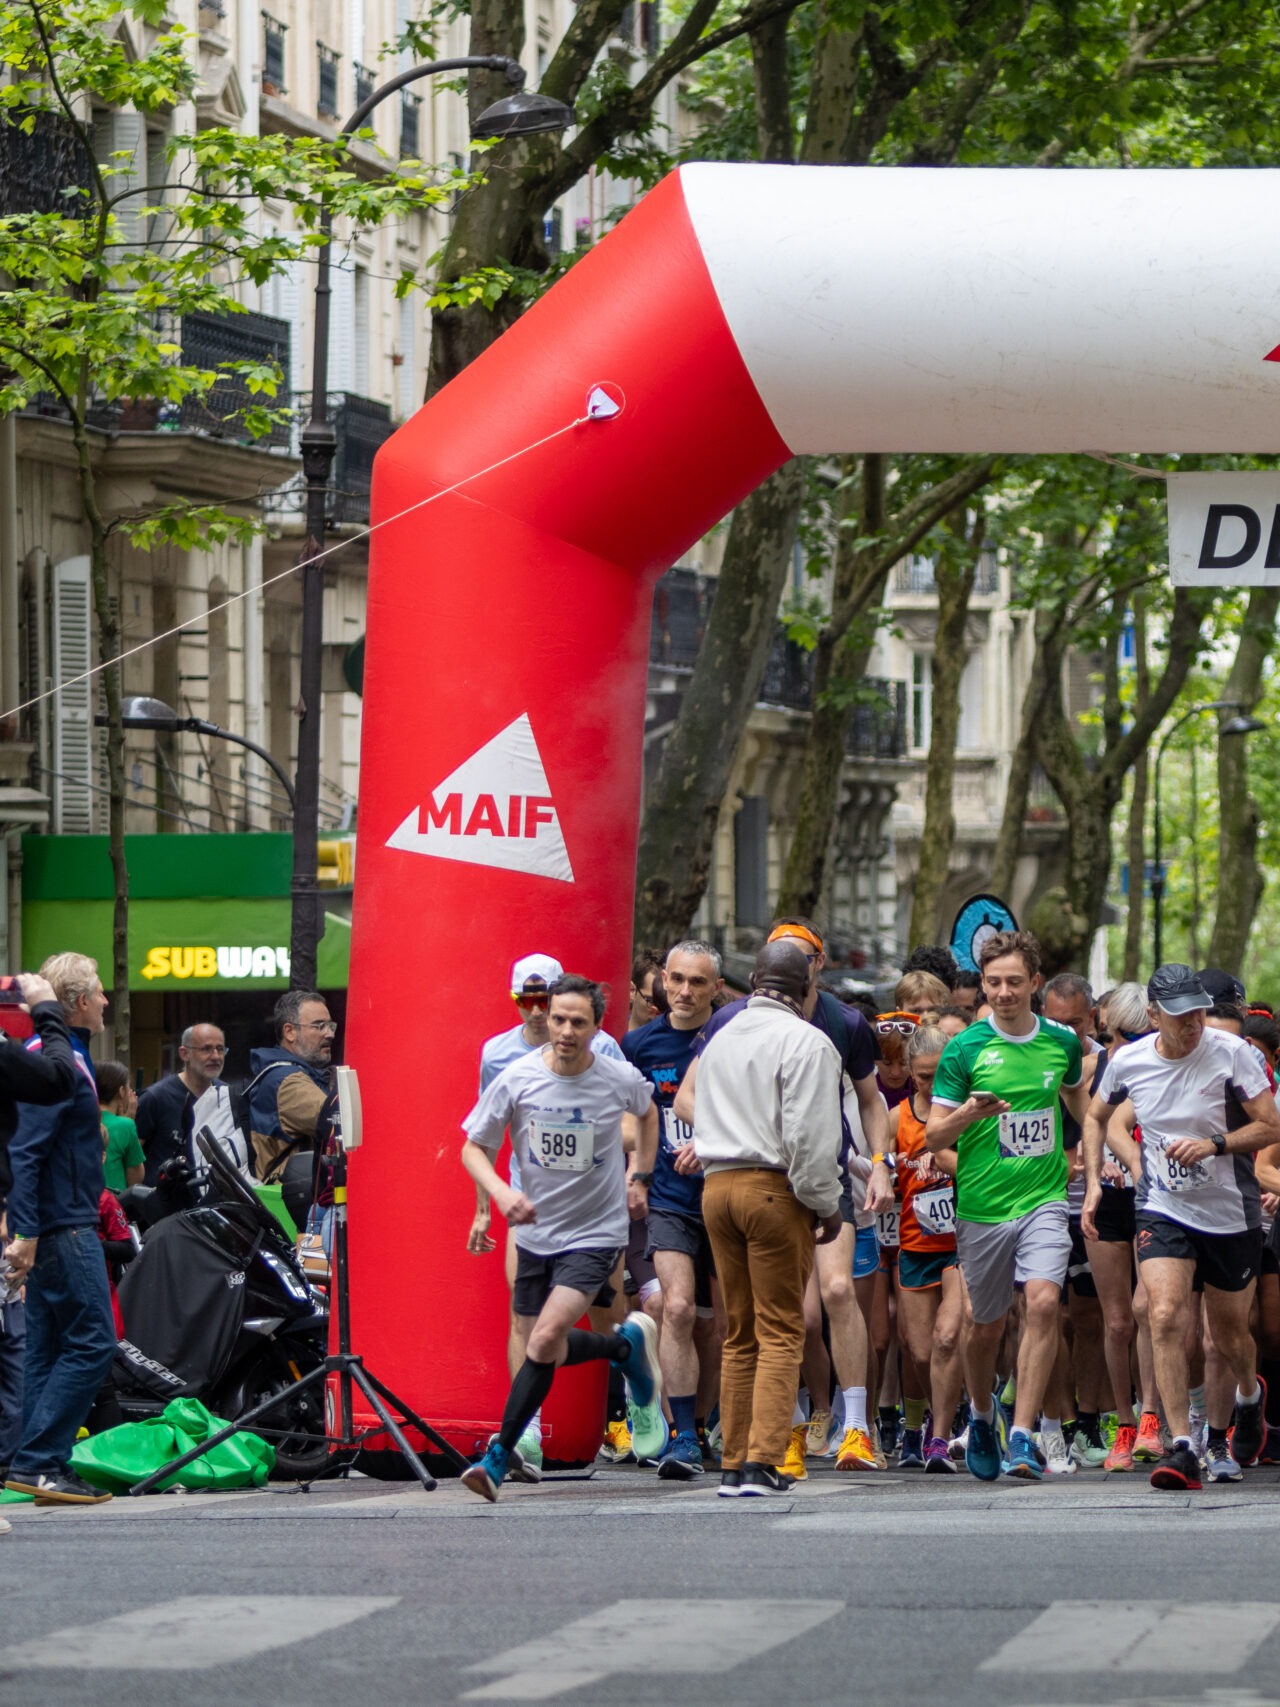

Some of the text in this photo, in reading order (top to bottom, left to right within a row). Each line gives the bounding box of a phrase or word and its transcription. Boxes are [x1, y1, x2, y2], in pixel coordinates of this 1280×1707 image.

[417, 792, 556, 838] MAIF
[140, 946, 291, 980] SUBWAY
[1009, 1118, 1049, 1144] 1425
[541, 1132, 577, 1157] 589
[878, 1212, 900, 1233] 12
